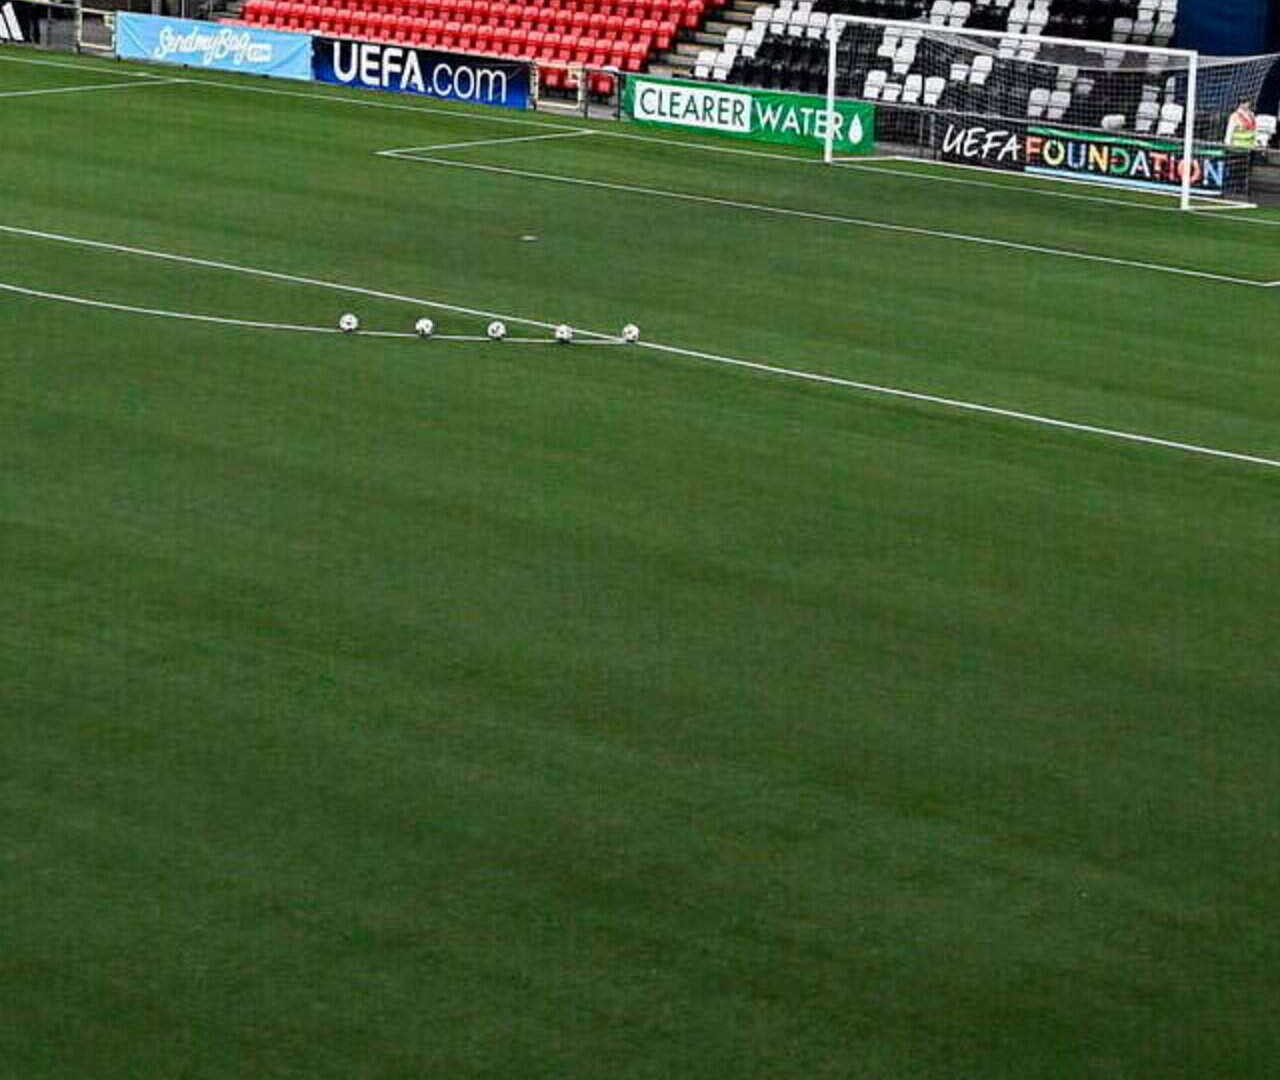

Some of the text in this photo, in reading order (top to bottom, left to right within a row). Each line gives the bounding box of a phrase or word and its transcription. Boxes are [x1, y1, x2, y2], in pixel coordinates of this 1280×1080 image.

[332, 40, 509, 103] UEFA.com
[639, 87, 844, 141] CLEARER WATER
[942, 123, 1224, 187] UEFA FOUNDATION
